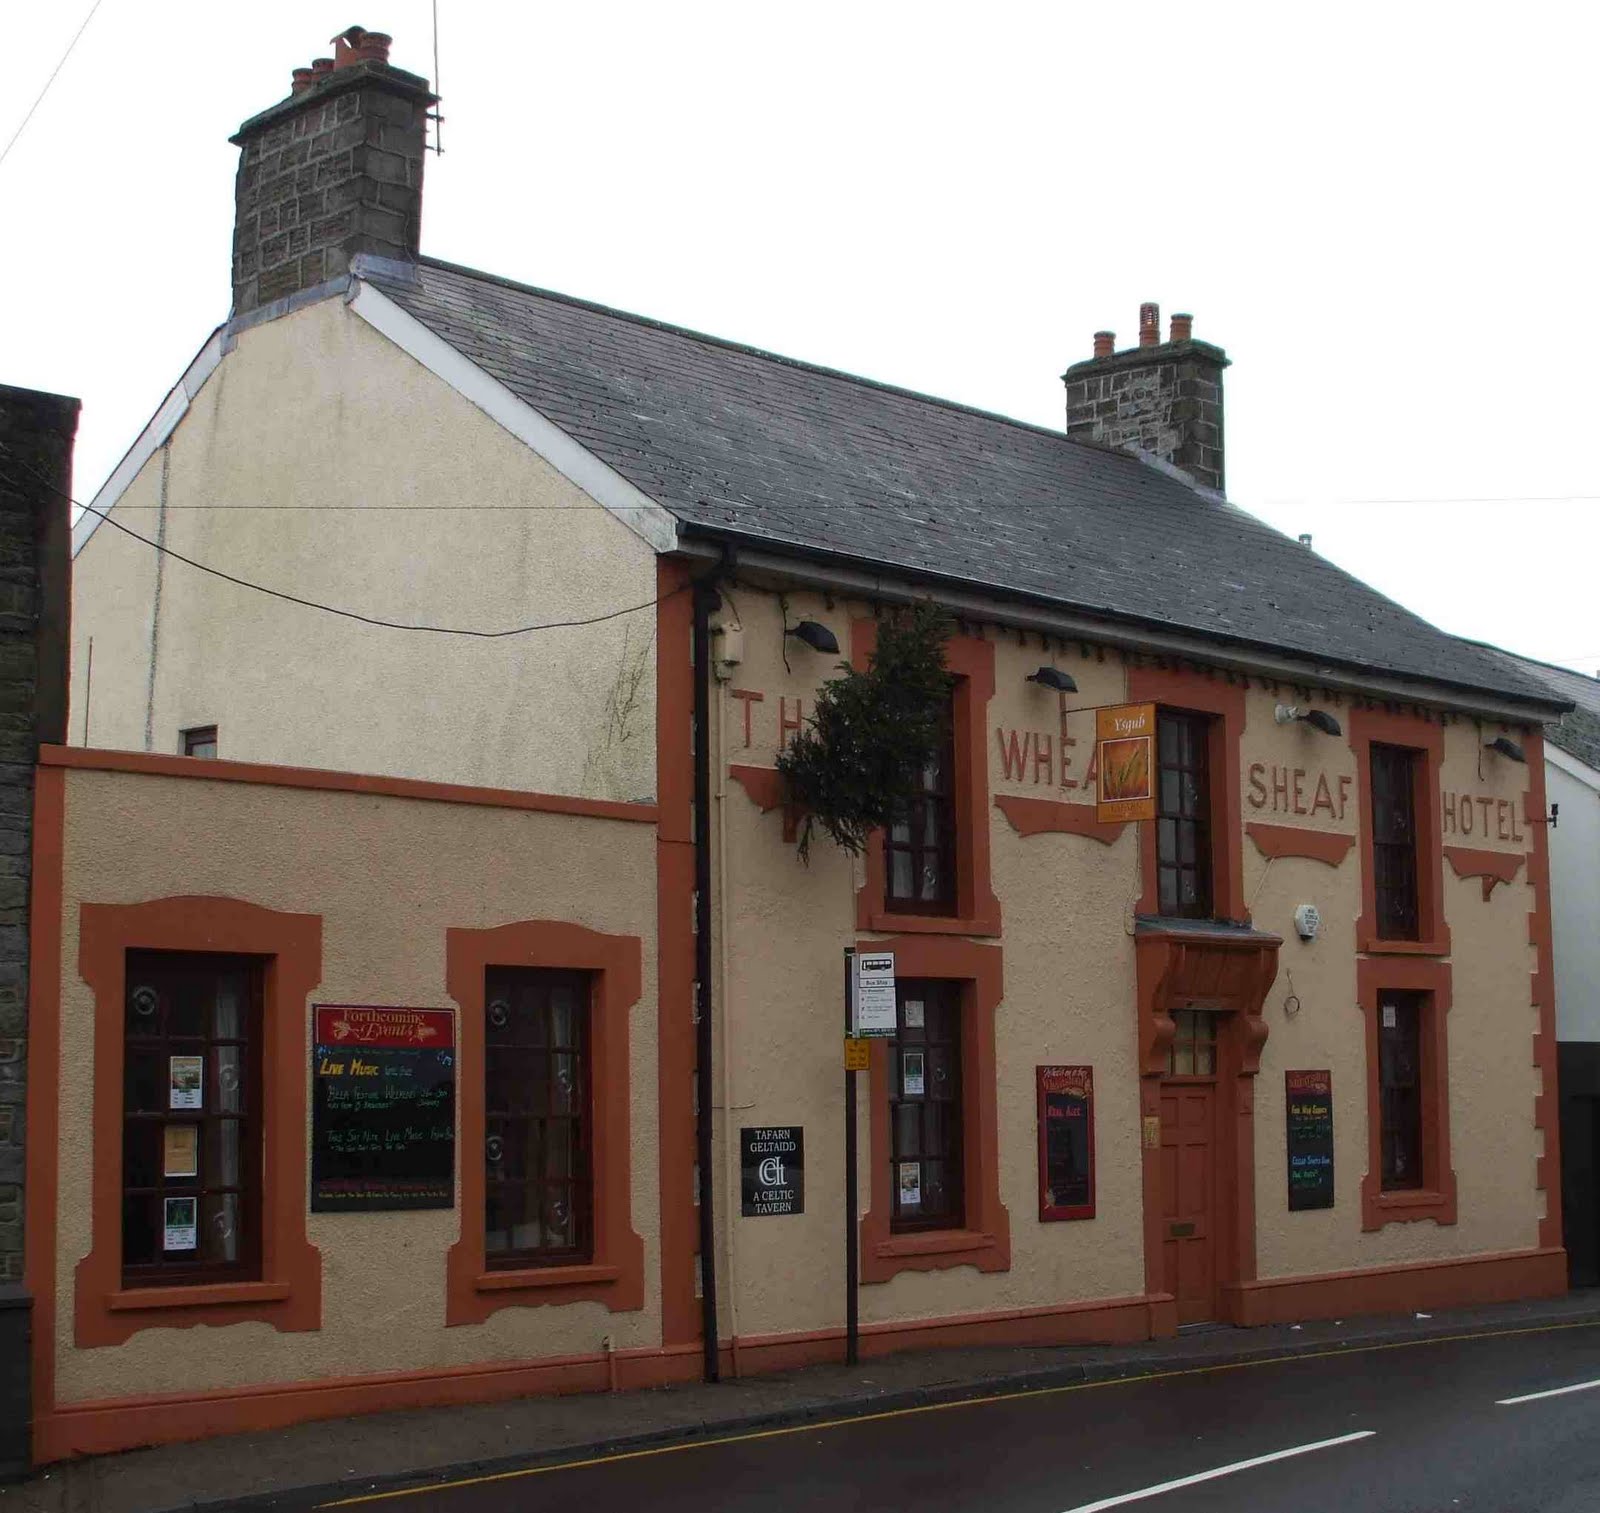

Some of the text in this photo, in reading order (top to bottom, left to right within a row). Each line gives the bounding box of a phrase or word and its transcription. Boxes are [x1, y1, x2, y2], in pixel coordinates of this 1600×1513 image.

[1114, 713, 1146, 737] Ysgub
[731, 689, 803, 751] TH
[1247, 762, 1352, 819] SHEAF
[1441, 790, 1525, 842] HOTEL
[343, 1010, 426, 1026] Forthcoming
[357, 1022, 414, 1041] Events
[755, 1129, 791, 1141] TAFARN
[749, 1141, 796, 1153] GELTAIDD
[753, 1189, 795, 1202] A CELTIC
[755, 1201, 792, 1214] TAVERN
